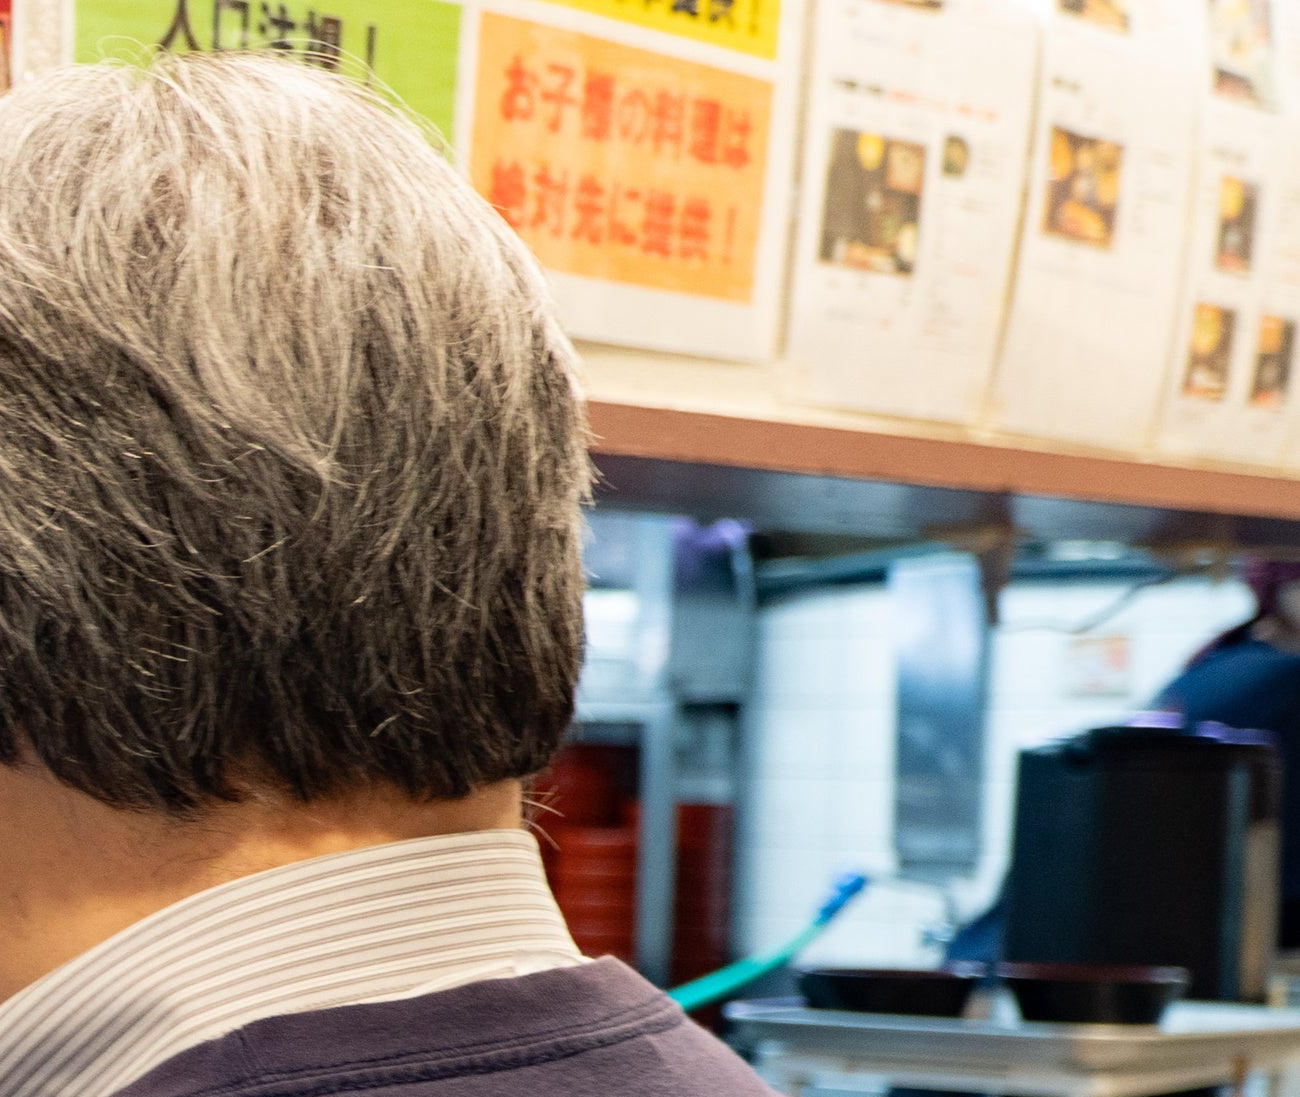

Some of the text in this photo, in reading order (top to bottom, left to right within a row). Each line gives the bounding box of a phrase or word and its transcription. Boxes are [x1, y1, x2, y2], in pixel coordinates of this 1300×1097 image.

[500, 55, 752, 169] お子様の料理は
